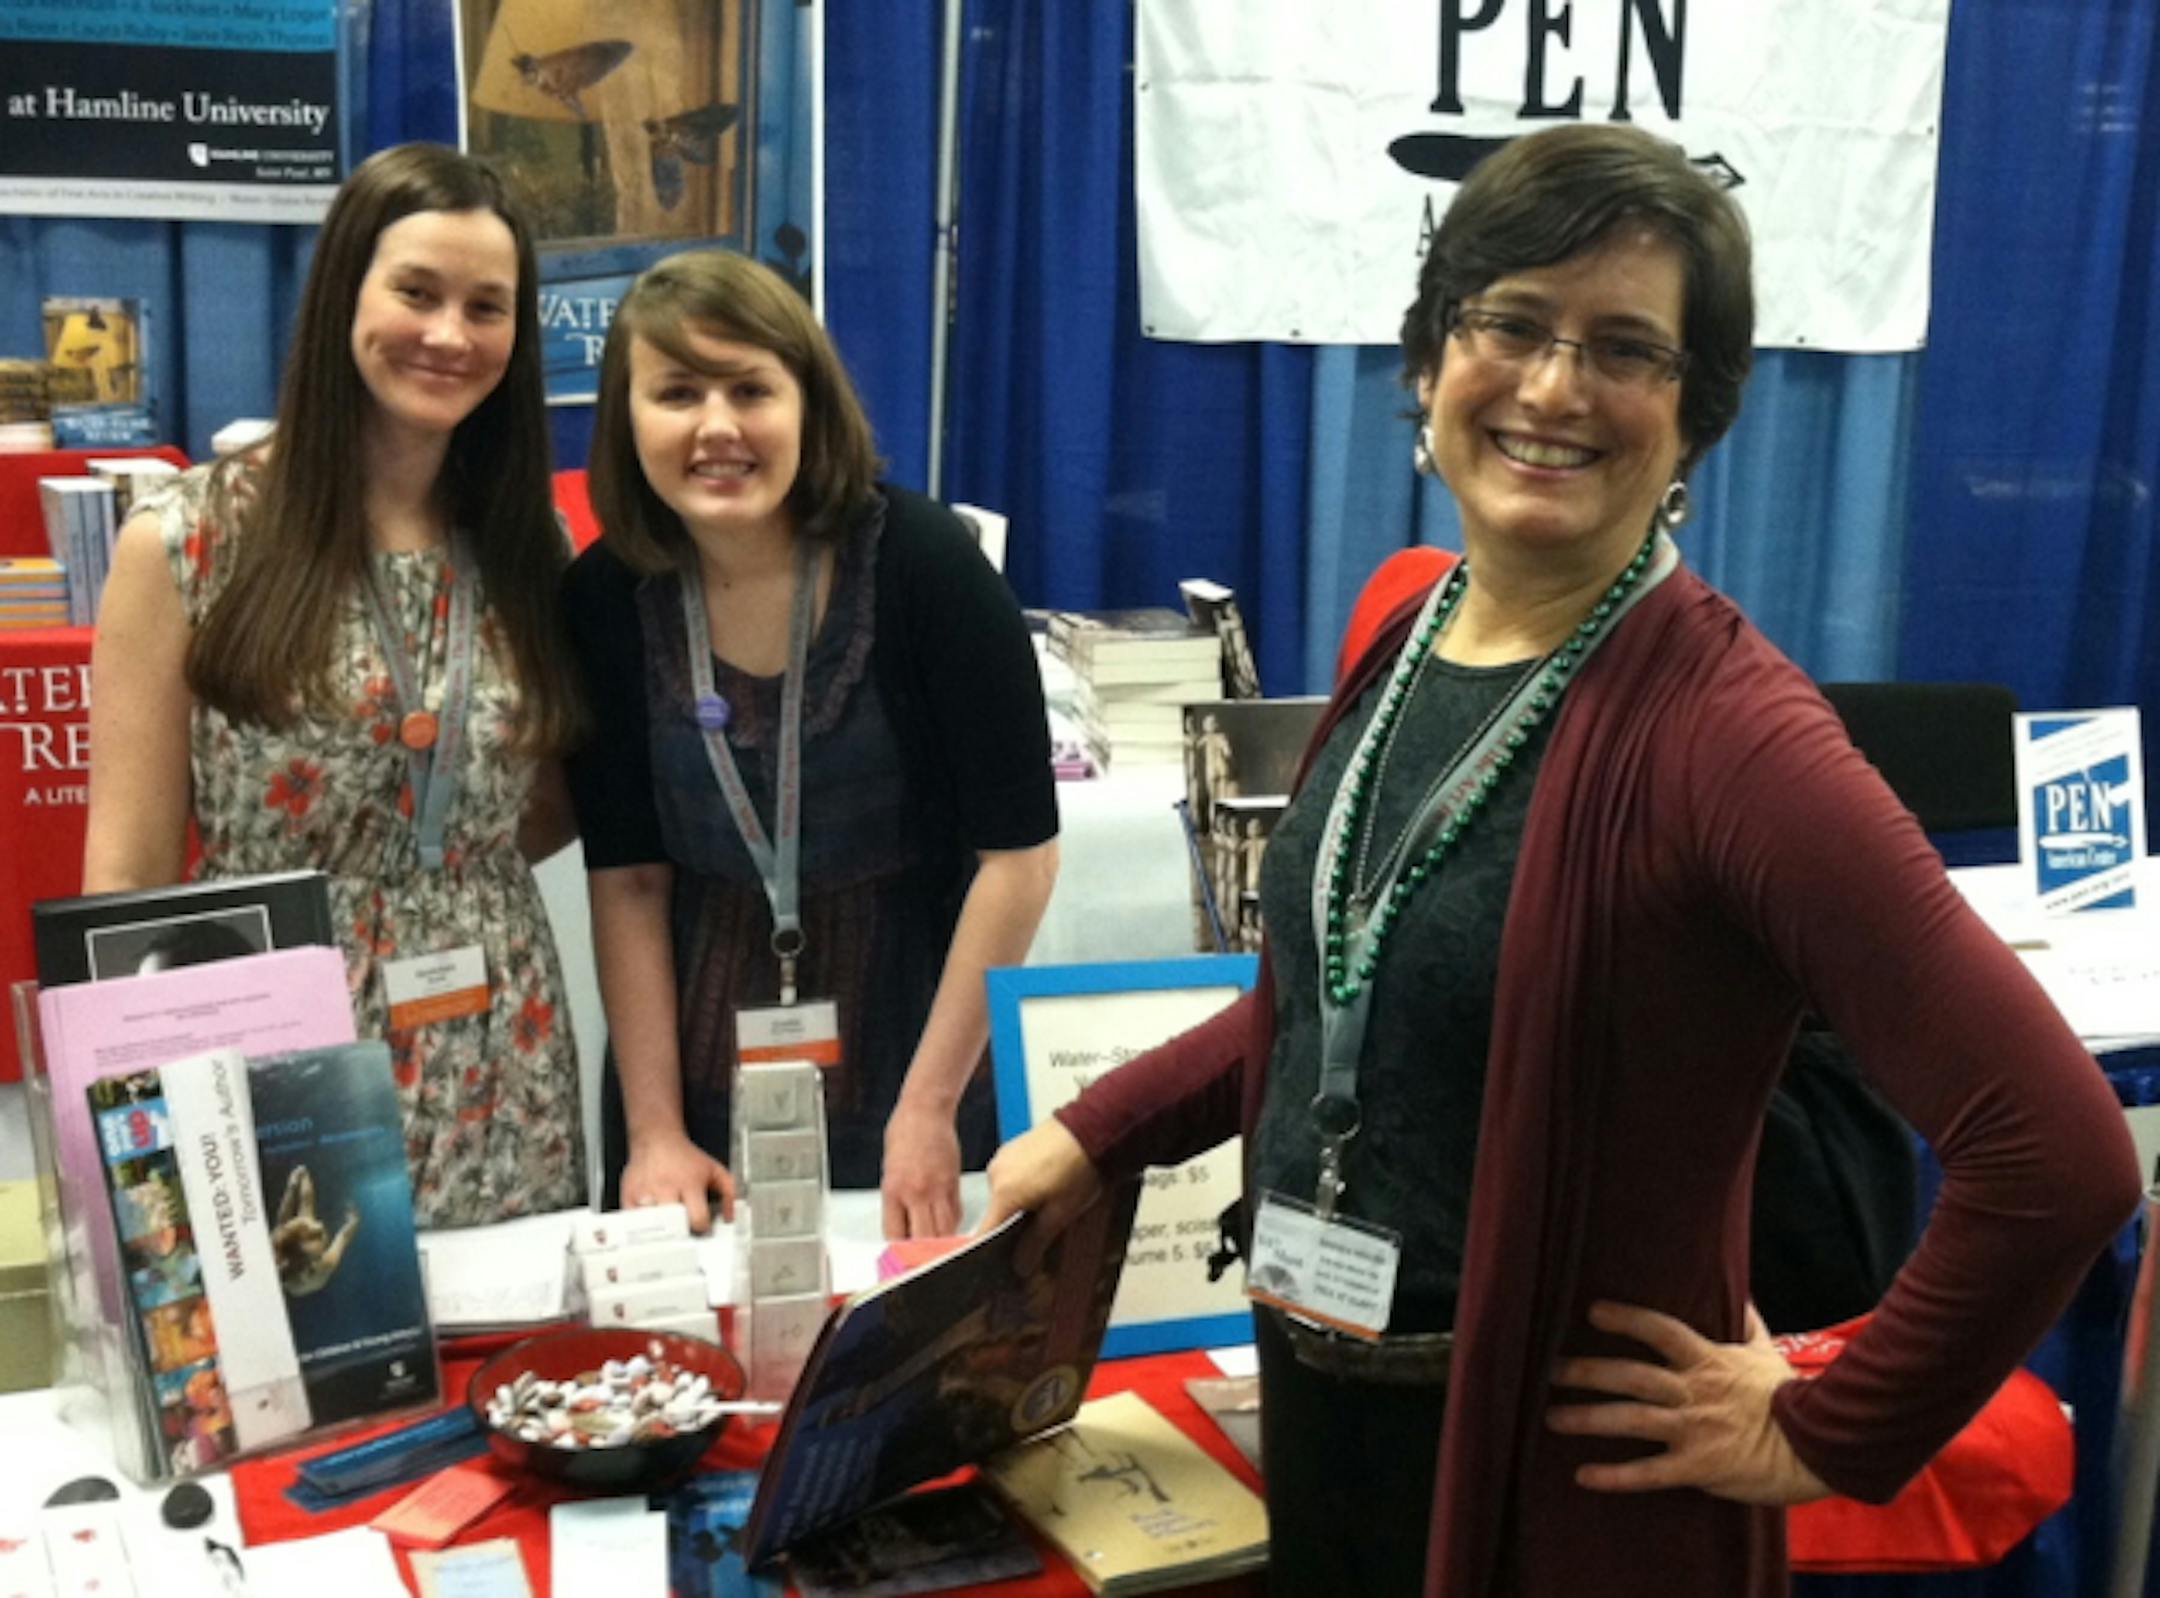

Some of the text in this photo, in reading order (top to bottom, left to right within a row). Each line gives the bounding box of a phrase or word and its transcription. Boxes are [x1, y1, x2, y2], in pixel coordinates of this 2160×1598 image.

[1429, 0, 1687, 121] PEN
[8, 87, 330, 135] at Hamline University
[23, 786, 43, 806] A
[2045, 783, 2113, 833] PEN
